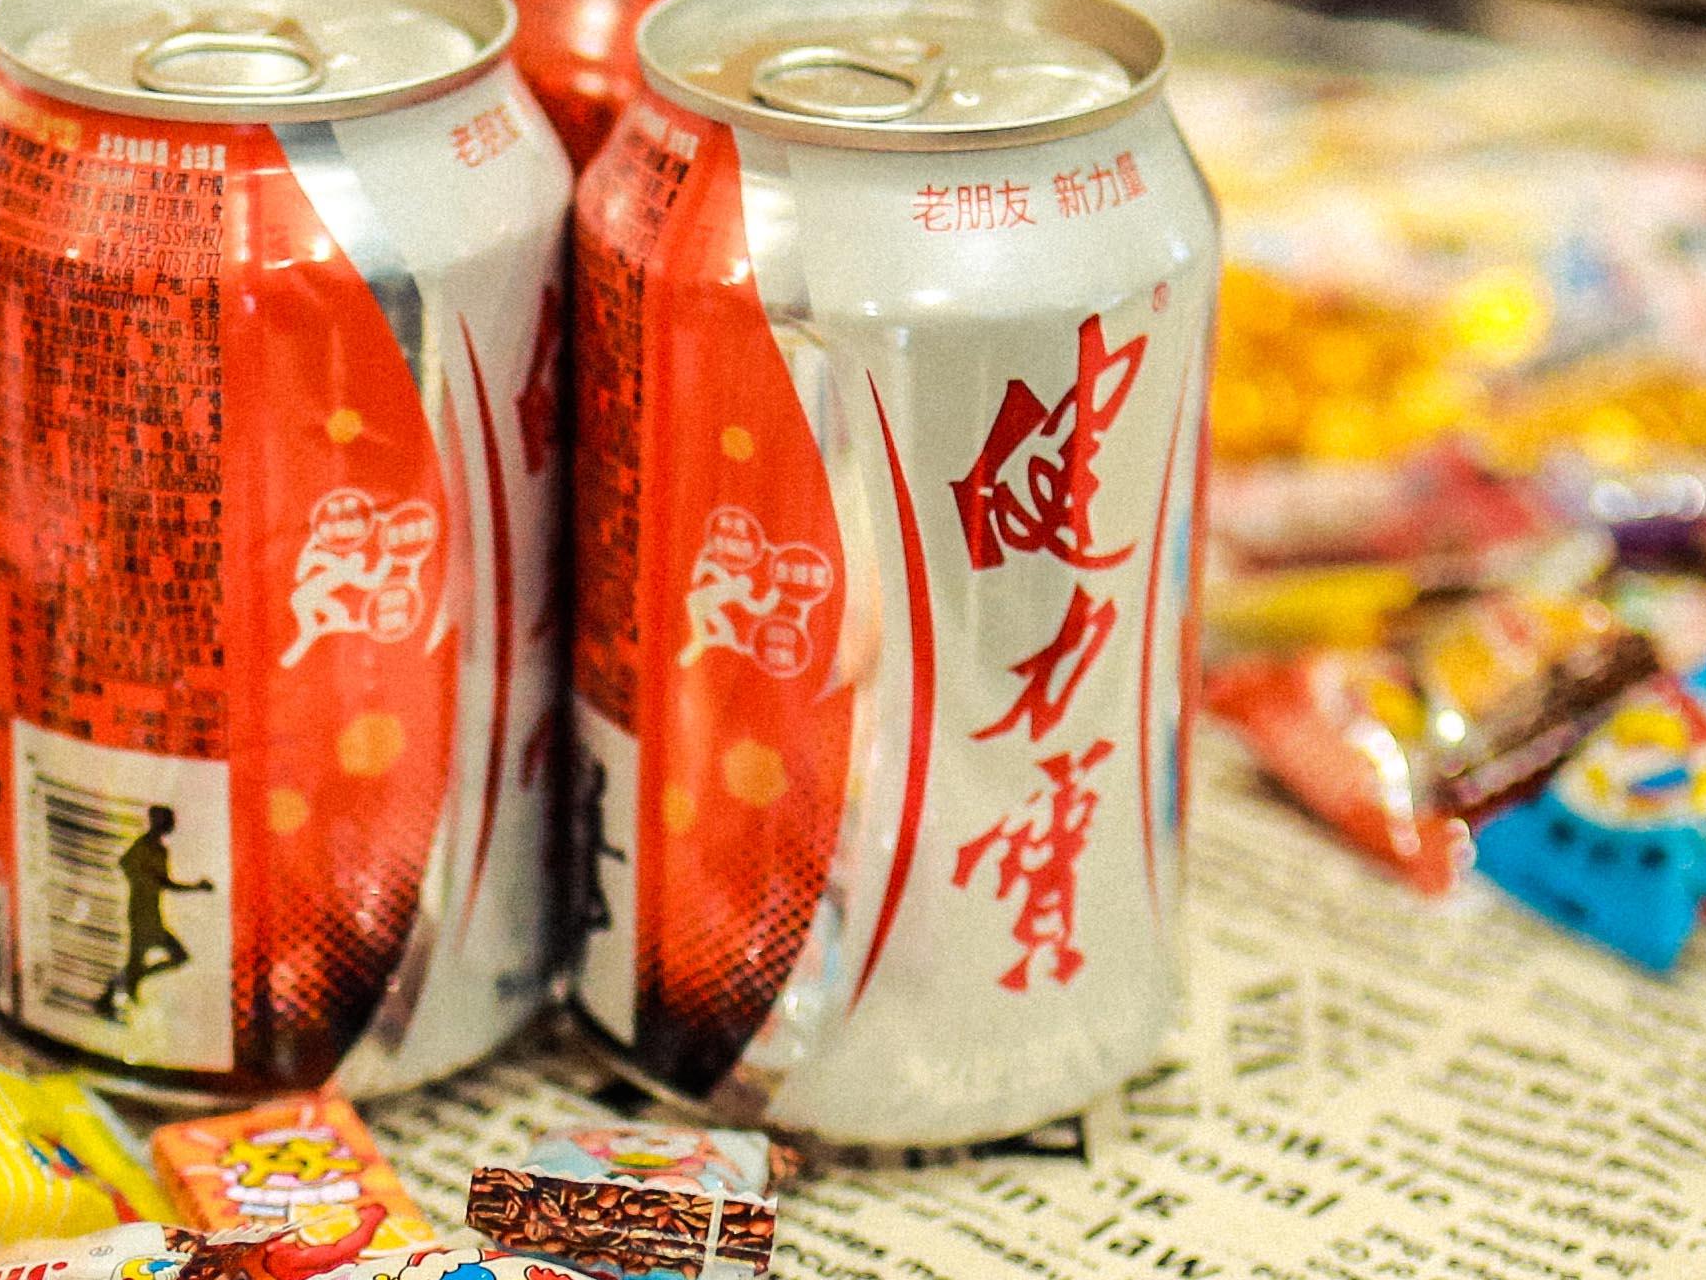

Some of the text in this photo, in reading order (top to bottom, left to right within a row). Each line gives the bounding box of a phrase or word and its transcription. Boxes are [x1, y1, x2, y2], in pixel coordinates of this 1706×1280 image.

[911, 150, 1149, 234] 老朋友 新力量
